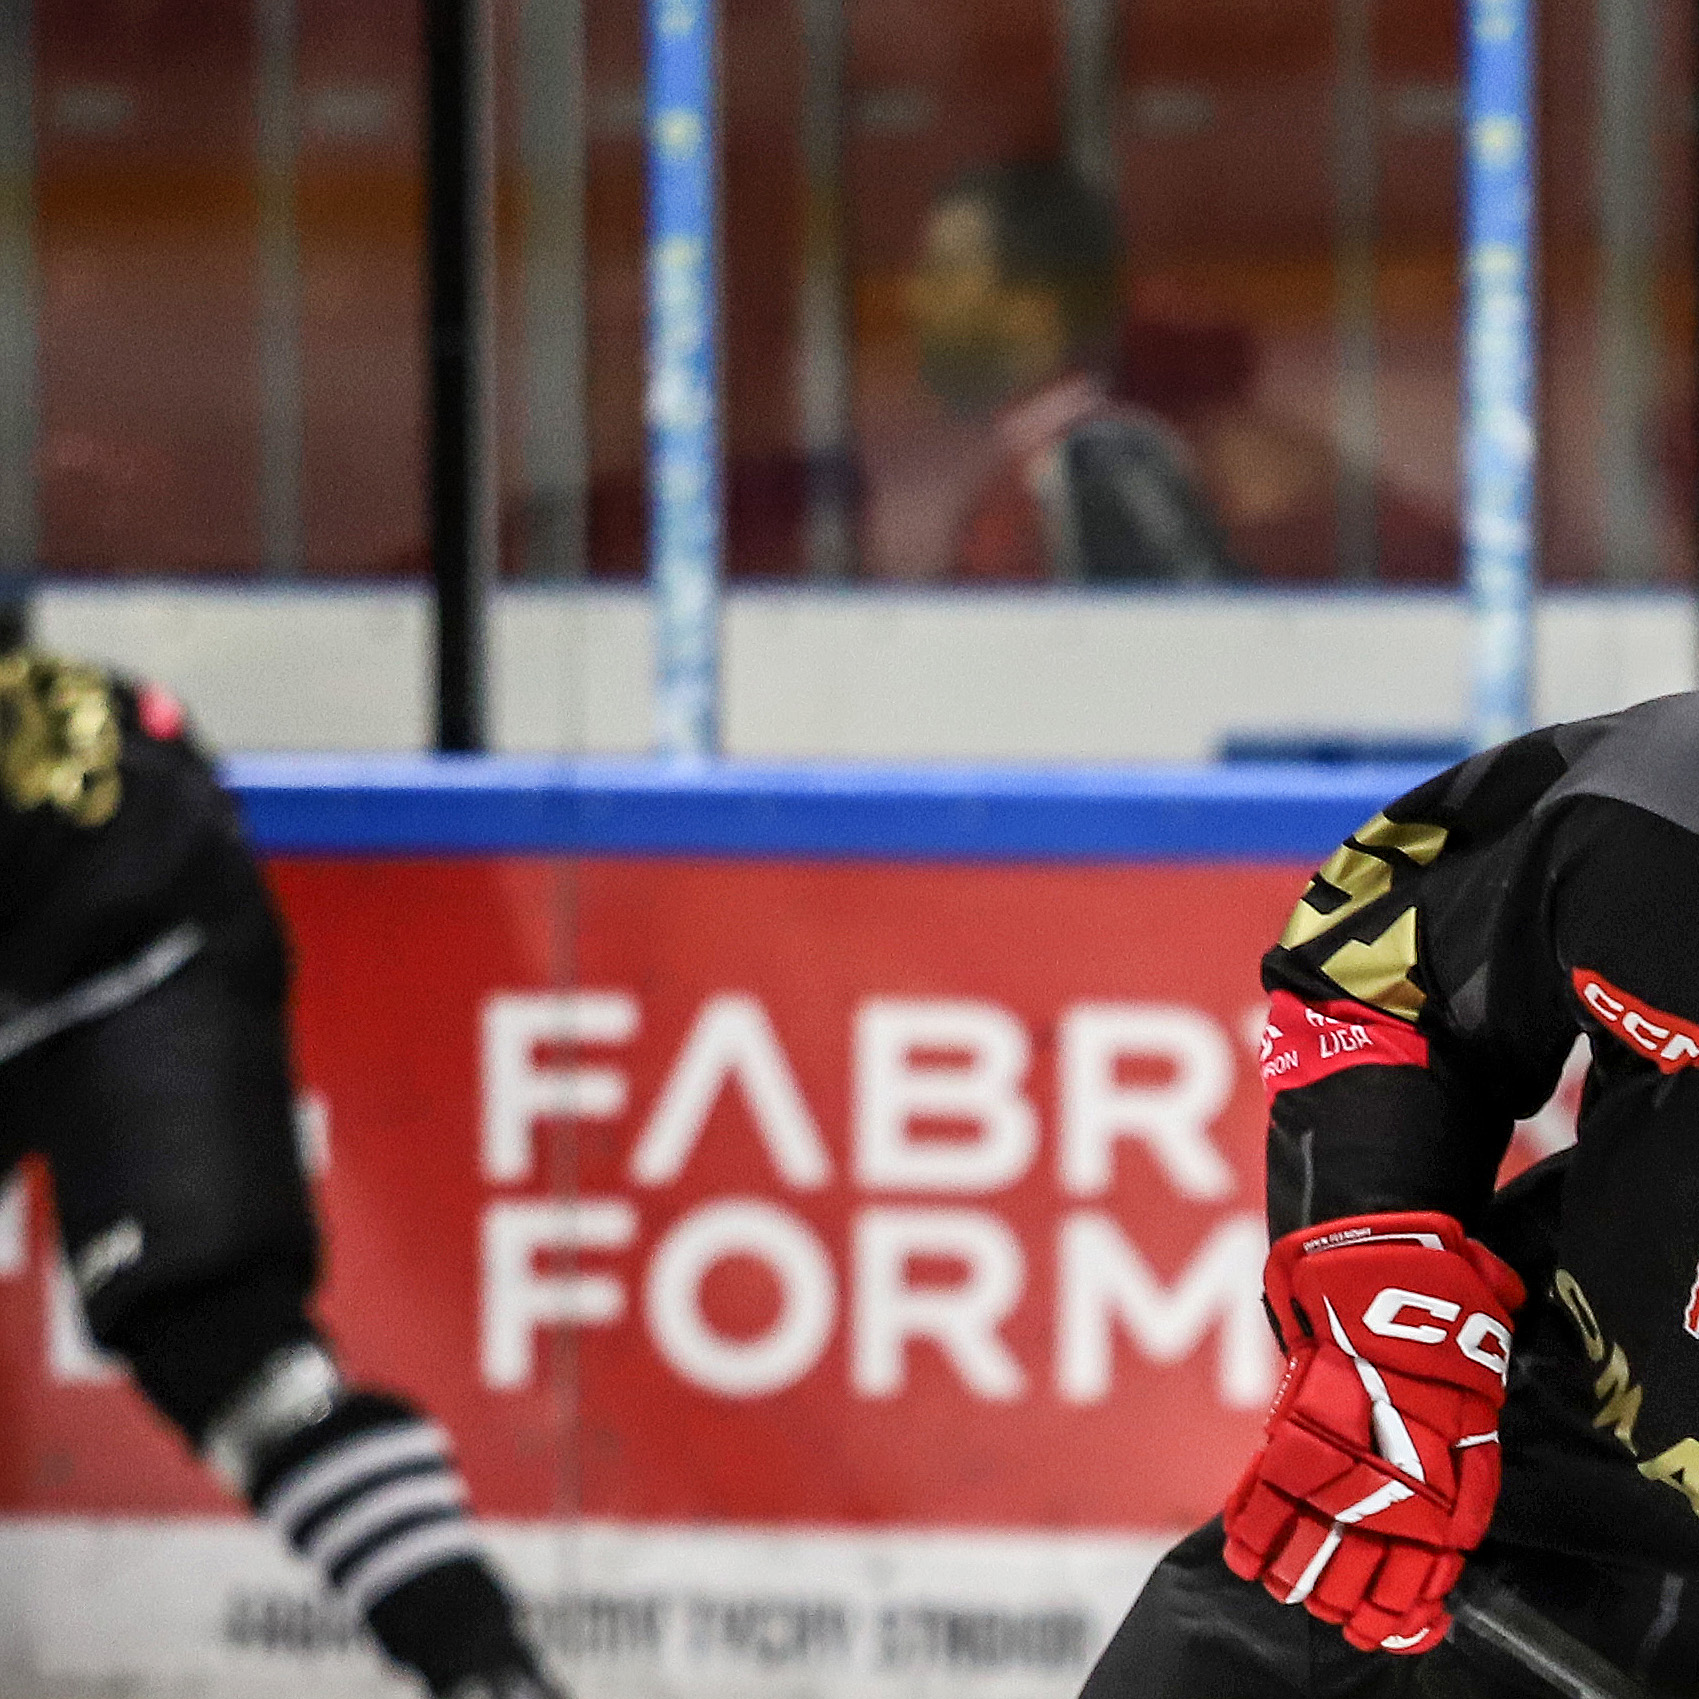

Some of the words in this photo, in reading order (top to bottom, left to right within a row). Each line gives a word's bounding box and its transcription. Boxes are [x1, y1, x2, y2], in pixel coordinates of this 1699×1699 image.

[478, 995, 1270, 1195] FABR
[1319, 1025, 1374, 1059] LIGA
[478, 1203, 1278, 1405] FORM
